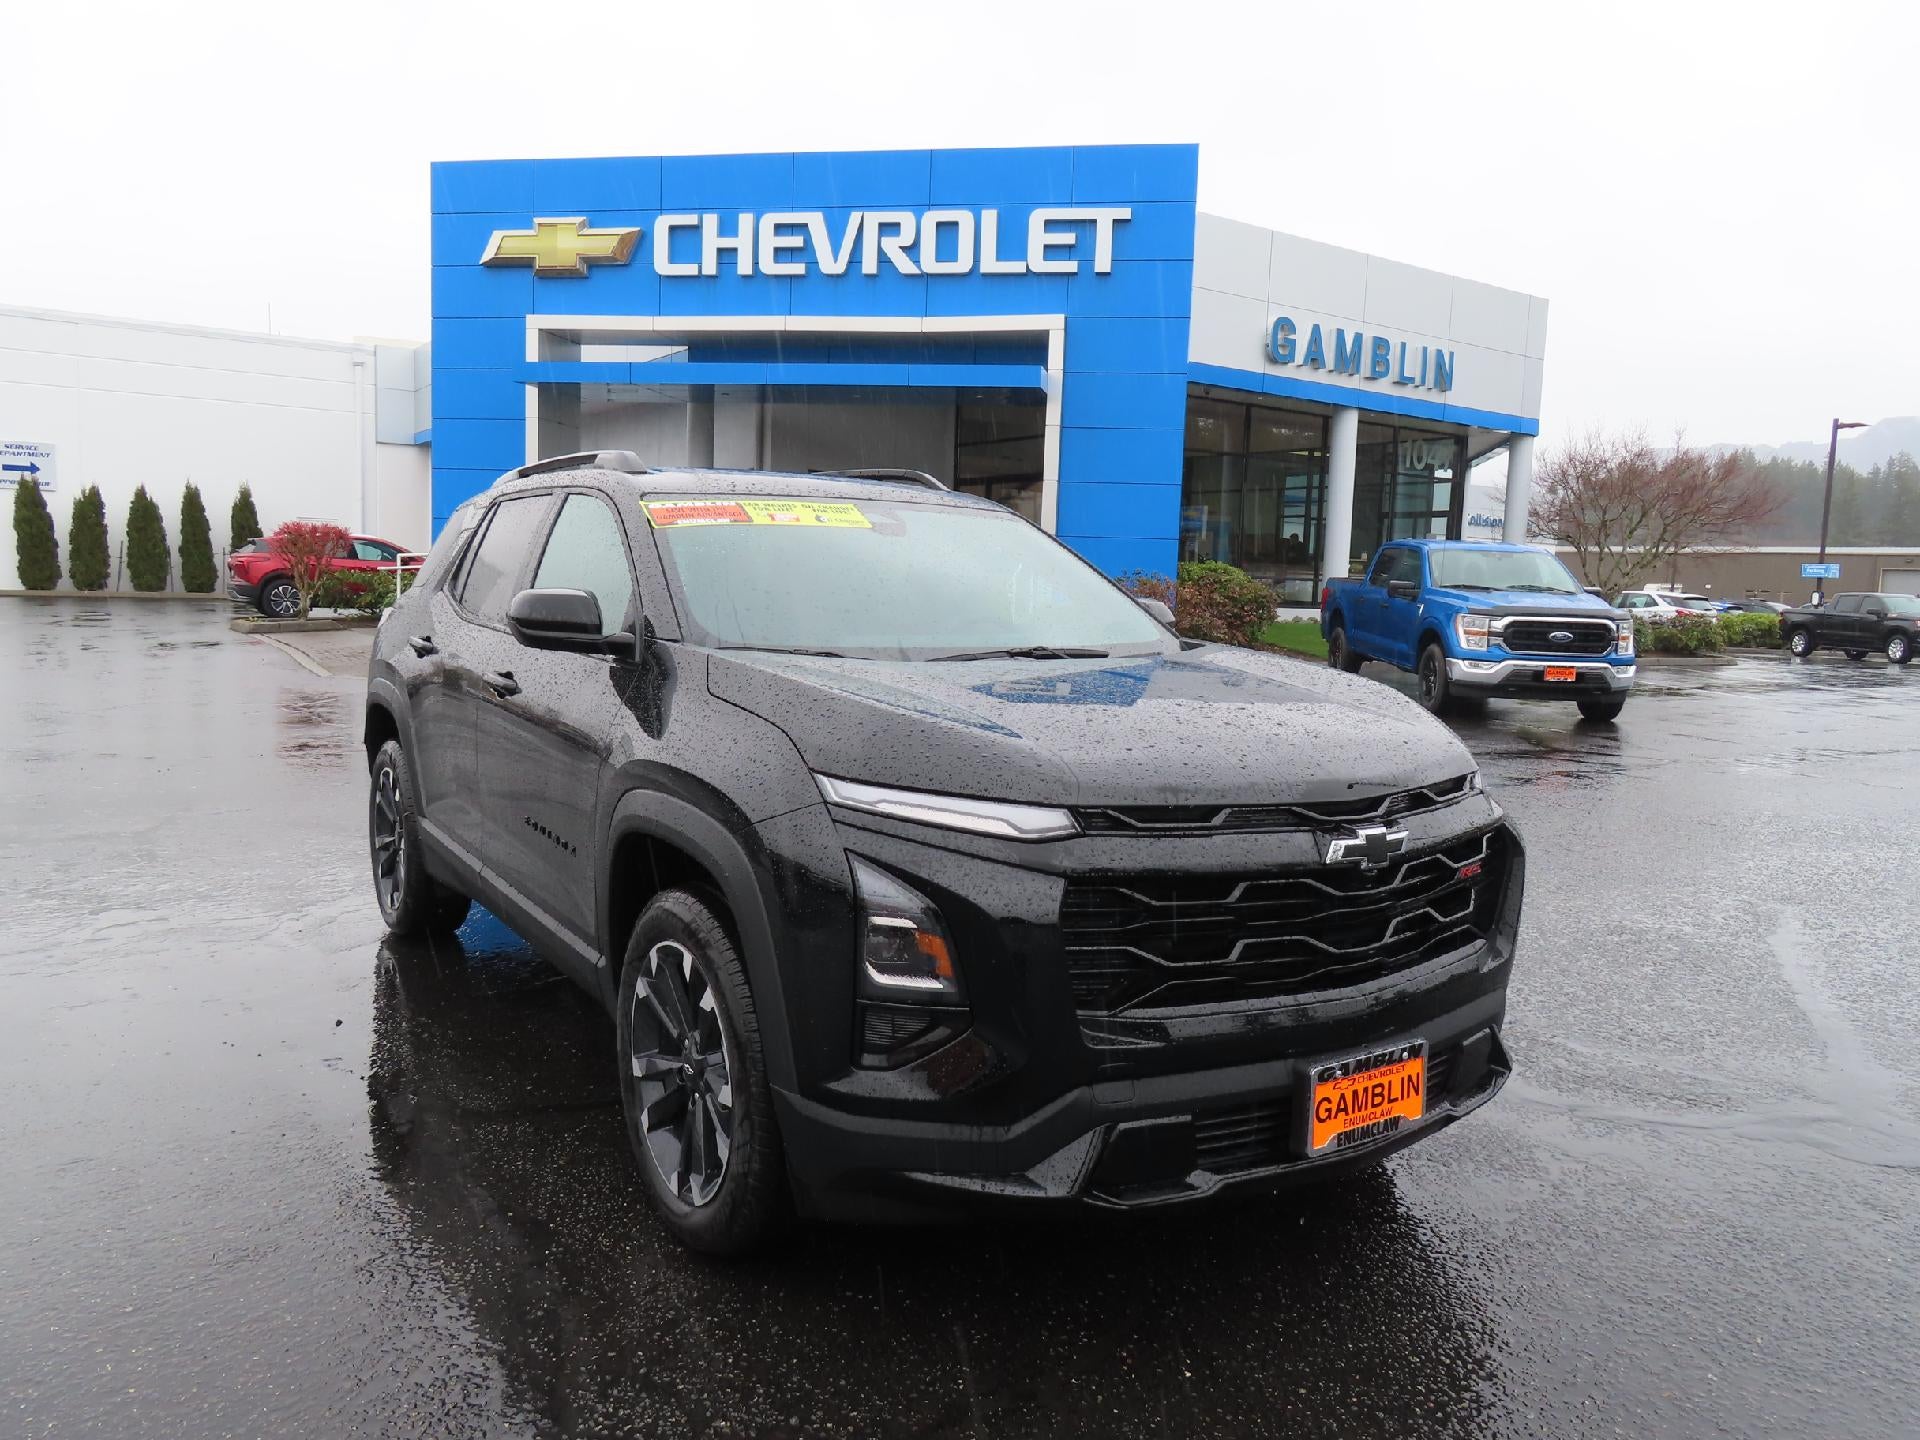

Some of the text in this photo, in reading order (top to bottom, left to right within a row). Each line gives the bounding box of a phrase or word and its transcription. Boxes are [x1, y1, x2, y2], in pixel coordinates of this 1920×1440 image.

[653, 207, 1132, 277] CHEVROLET
[1268, 316, 1455, 392] GAMBLIN
[0, 450, 51, 458] EPARTMENT
[4, 443, 39, 451] SERVICE
[1468, 513, 1504, 527] ollision
[1317, 1043, 1423, 1082] GAMBLIN
[1357, 1064, 1406, 1083] CHEVROLET
[1315, 1072, 1420, 1124] GAMBLIN
[1336, 1115, 1401, 1147] ENUMCLAW
[1343, 1107, 1394, 1129] ENUMCLAW
